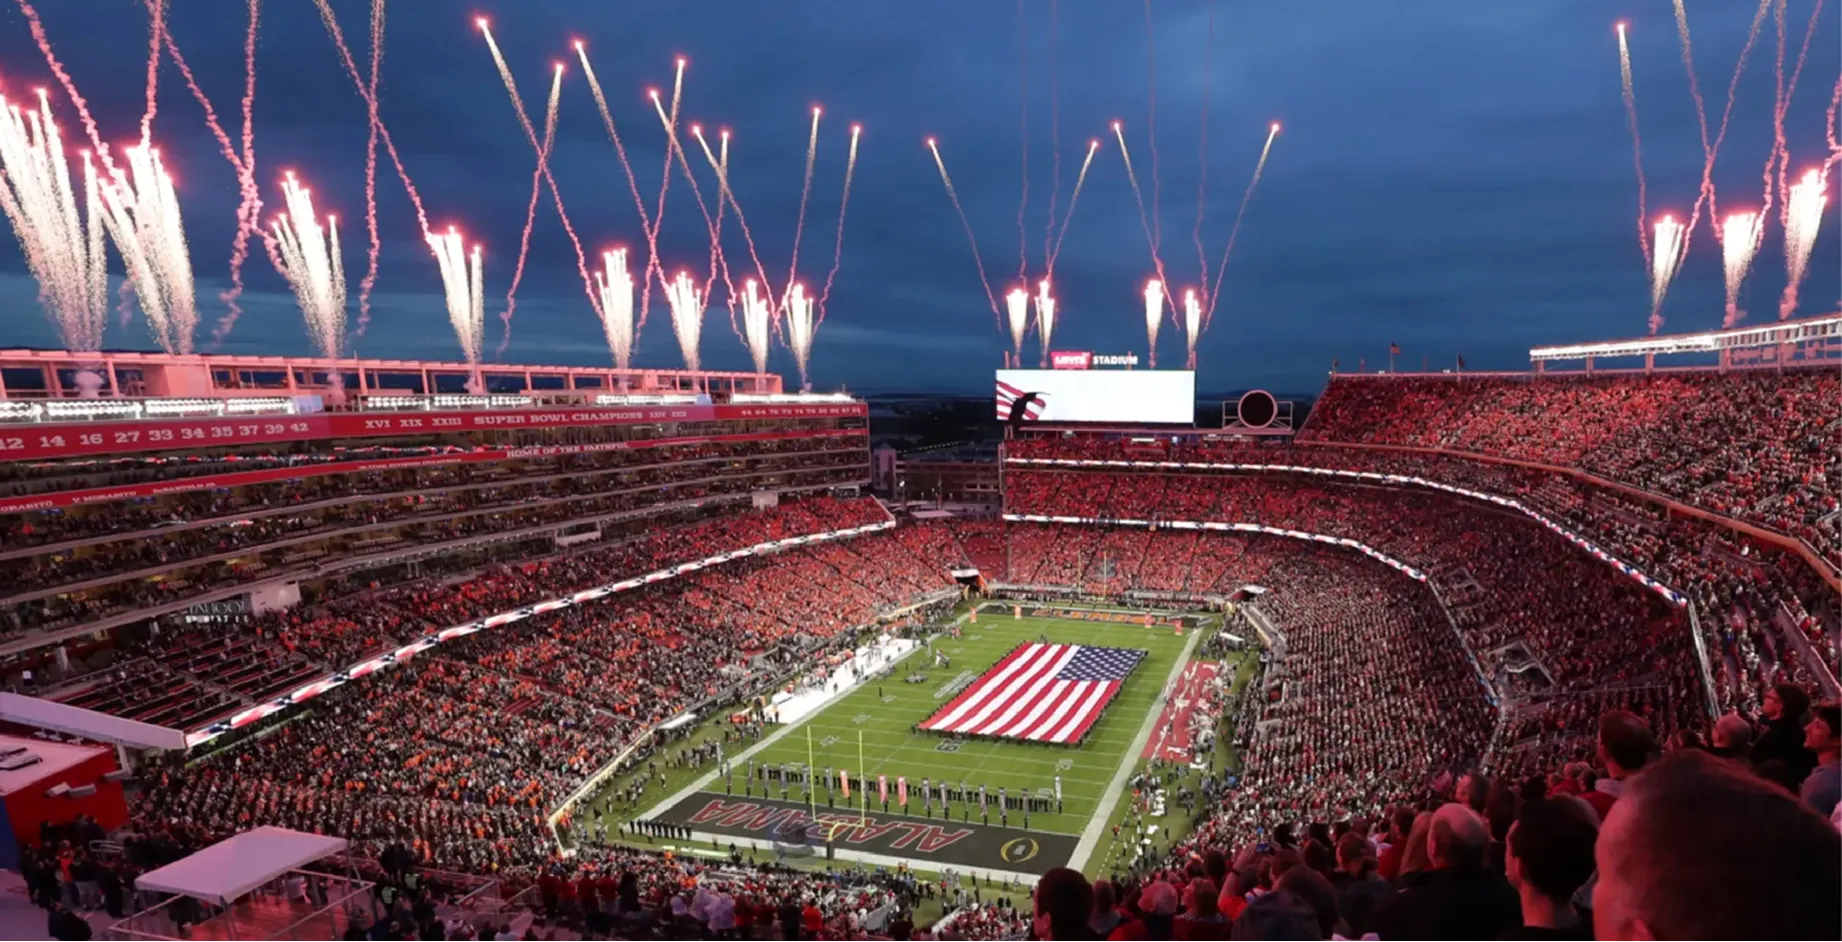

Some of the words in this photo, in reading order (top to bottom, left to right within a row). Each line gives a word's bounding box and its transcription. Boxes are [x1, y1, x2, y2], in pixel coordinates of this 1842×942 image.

[1093, 355, 1138, 365] STADIUM
[365, 419, 391, 429] XVI
[400, 418, 423, 427] XIX
[431, 417, 462, 426] XXIII
[474, 414, 526, 425] SUPER
[530, 413, 570, 423] BOWL
[571, 411, 643, 421] CHAMPIONS
[0, 437, 25, 450] 12
[39, 434, 66, 448] 14
[79, 433, 103, 445] 16
[114, 430, 140, 443] 27
[148, 428, 173, 441] 33
[181, 427, 205, 440] 34
[211, 426, 233, 438] 35
[239, 424, 259, 437] 37
[264, 423, 285, 435] 39
[290, 422, 309, 432] 42
[507, 448, 540, 459] HOME
[543, 446, 557, 455] OF
[560, 445, 581, 454] THE
[584, 442, 630, 452] FAITHFUL
[687, 799, 974, 853] ALABAMA
